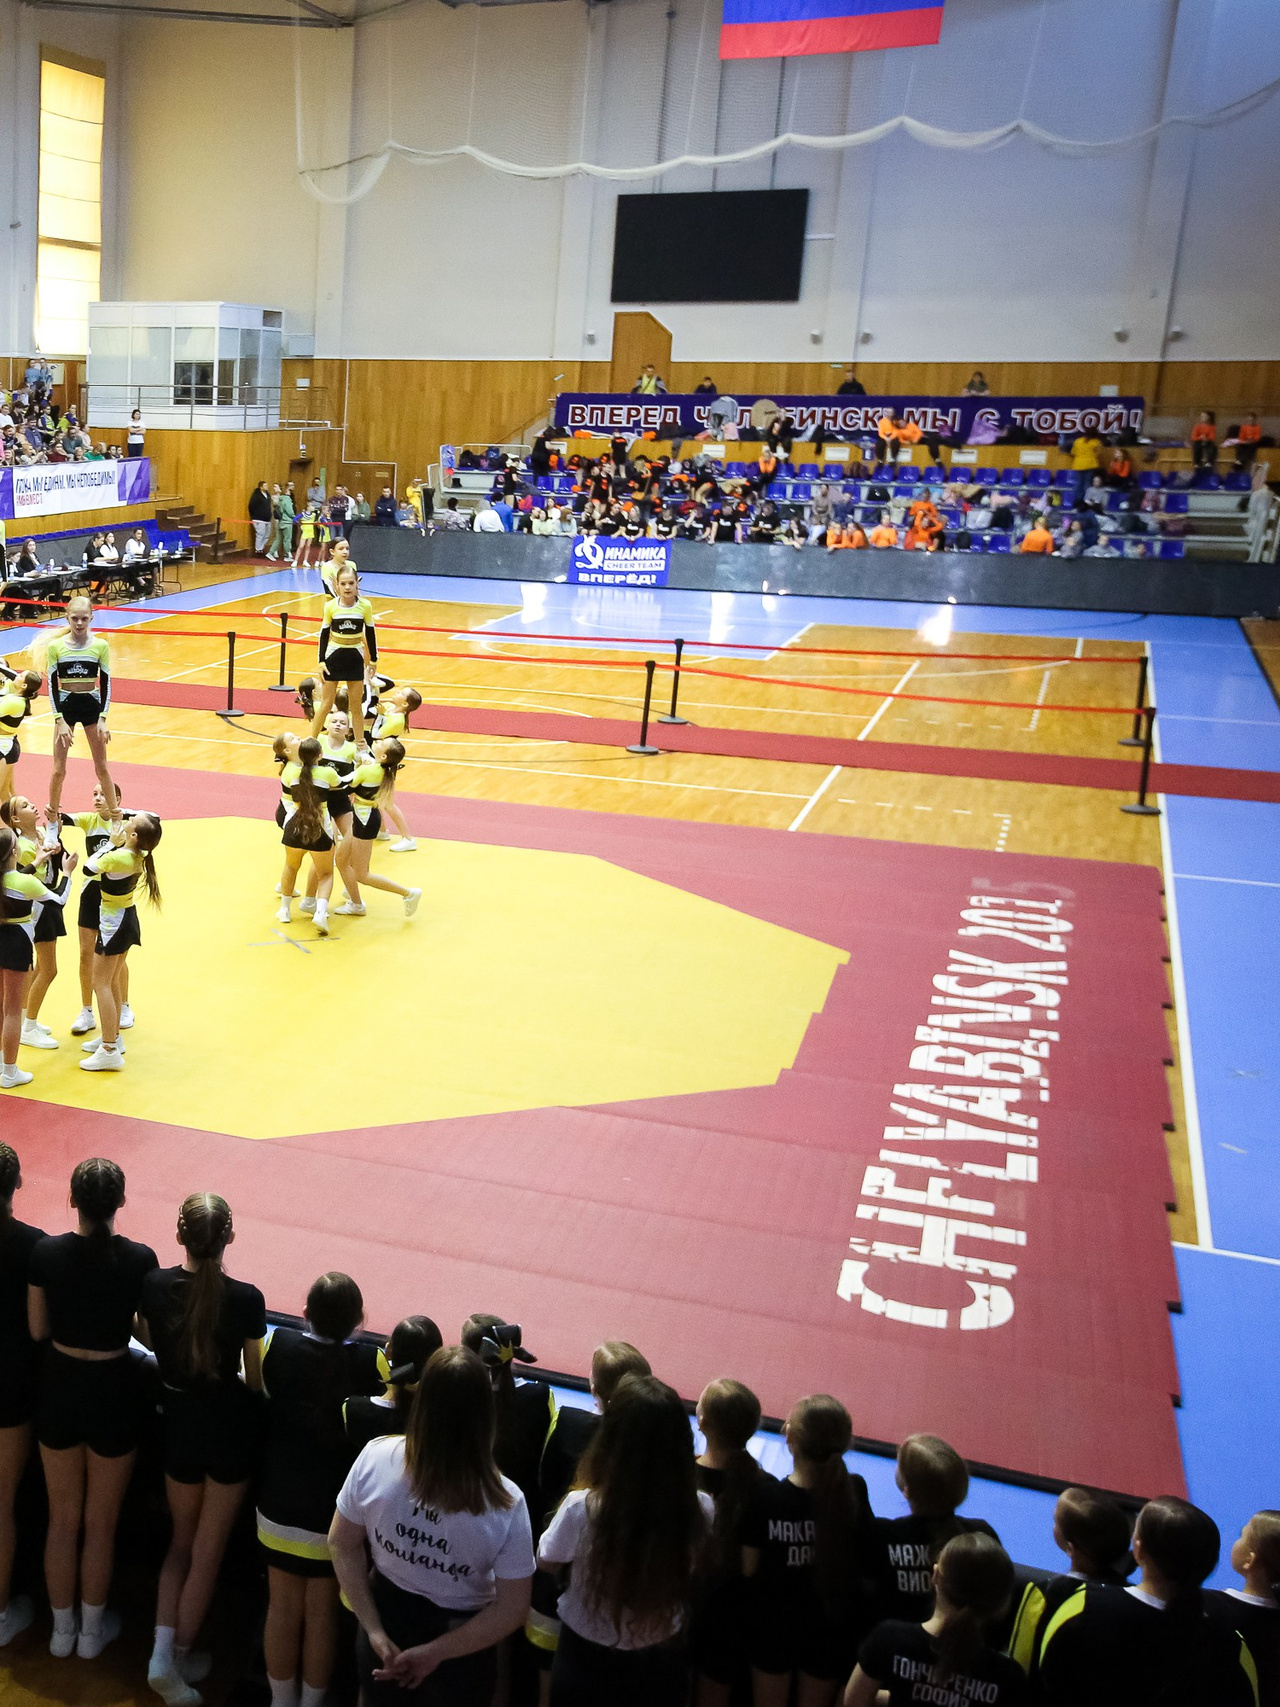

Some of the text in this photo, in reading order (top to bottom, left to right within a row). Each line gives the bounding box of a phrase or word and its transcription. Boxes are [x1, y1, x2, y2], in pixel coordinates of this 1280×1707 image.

[568, 404, 682, 428] ВПЕРЕД
[694, 405, 882, 431] ЧЛБИНСК
[904, 407, 962, 433] МЫ
[578, 572, 657, 586] ВПЕРЁД!
[836, 948, 1069, 1331] CHELYABINSK
[374, 1527, 477, 1582] команда
[395, 1521, 452, 1555] одна
